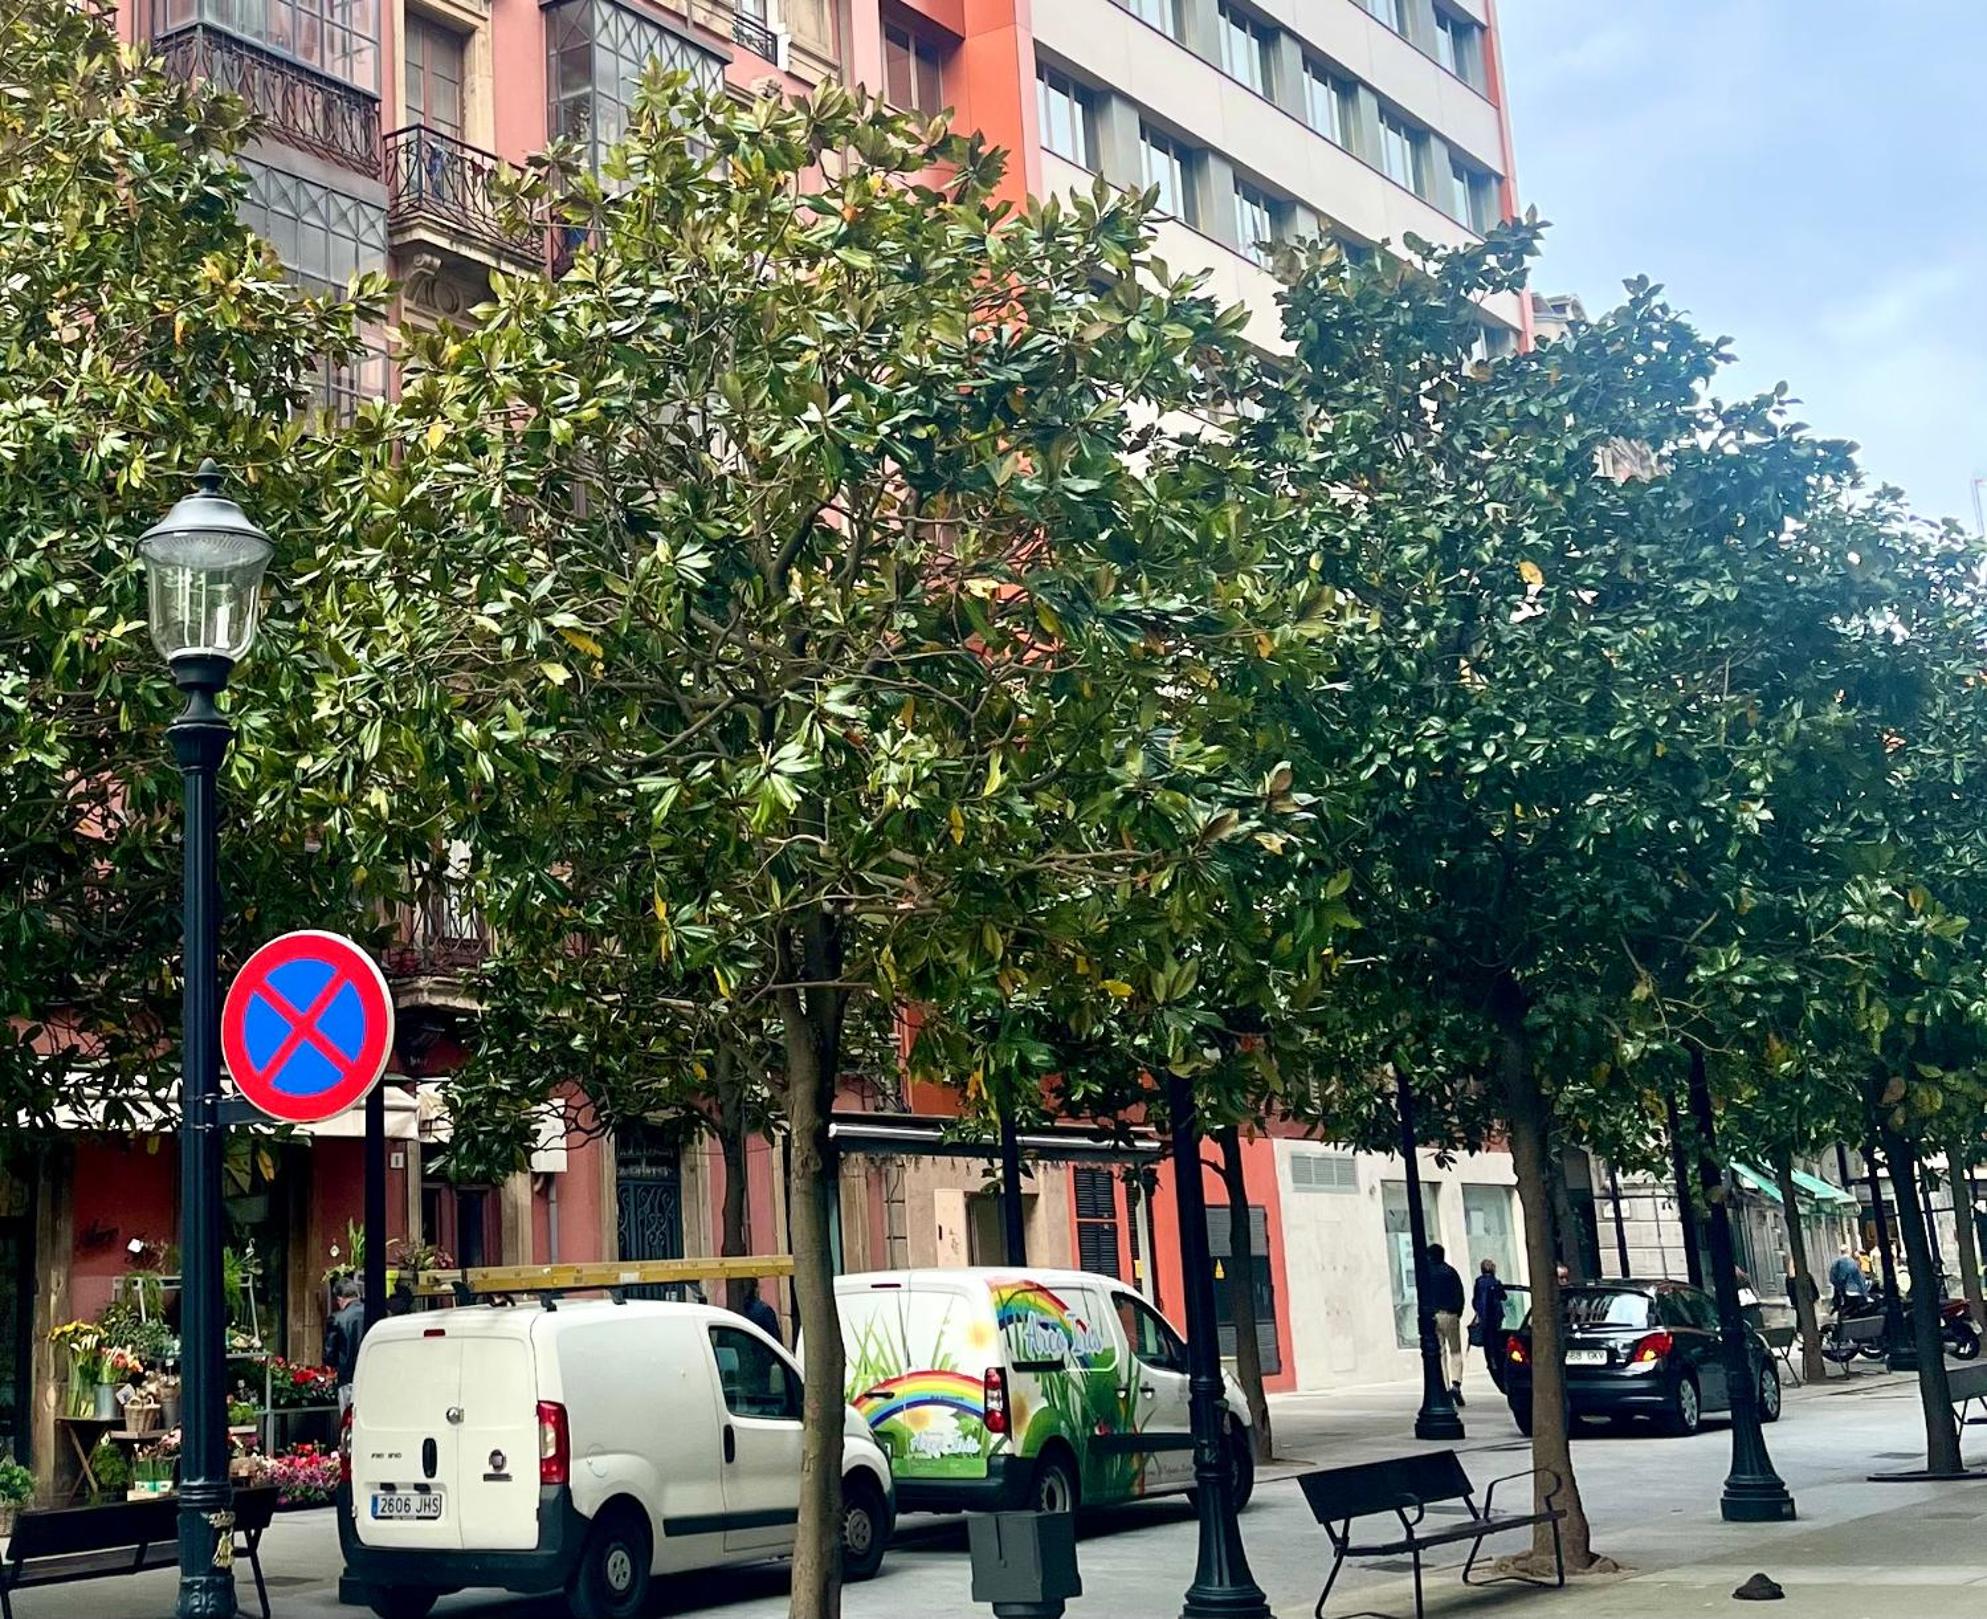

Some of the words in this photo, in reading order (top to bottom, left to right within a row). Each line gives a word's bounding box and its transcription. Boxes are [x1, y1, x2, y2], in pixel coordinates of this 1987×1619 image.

[1026, 1311, 1067, 1358] Arco
[380, 1497, 411, 1513] 2606
[416, 1497, 439, 1513] JHS
